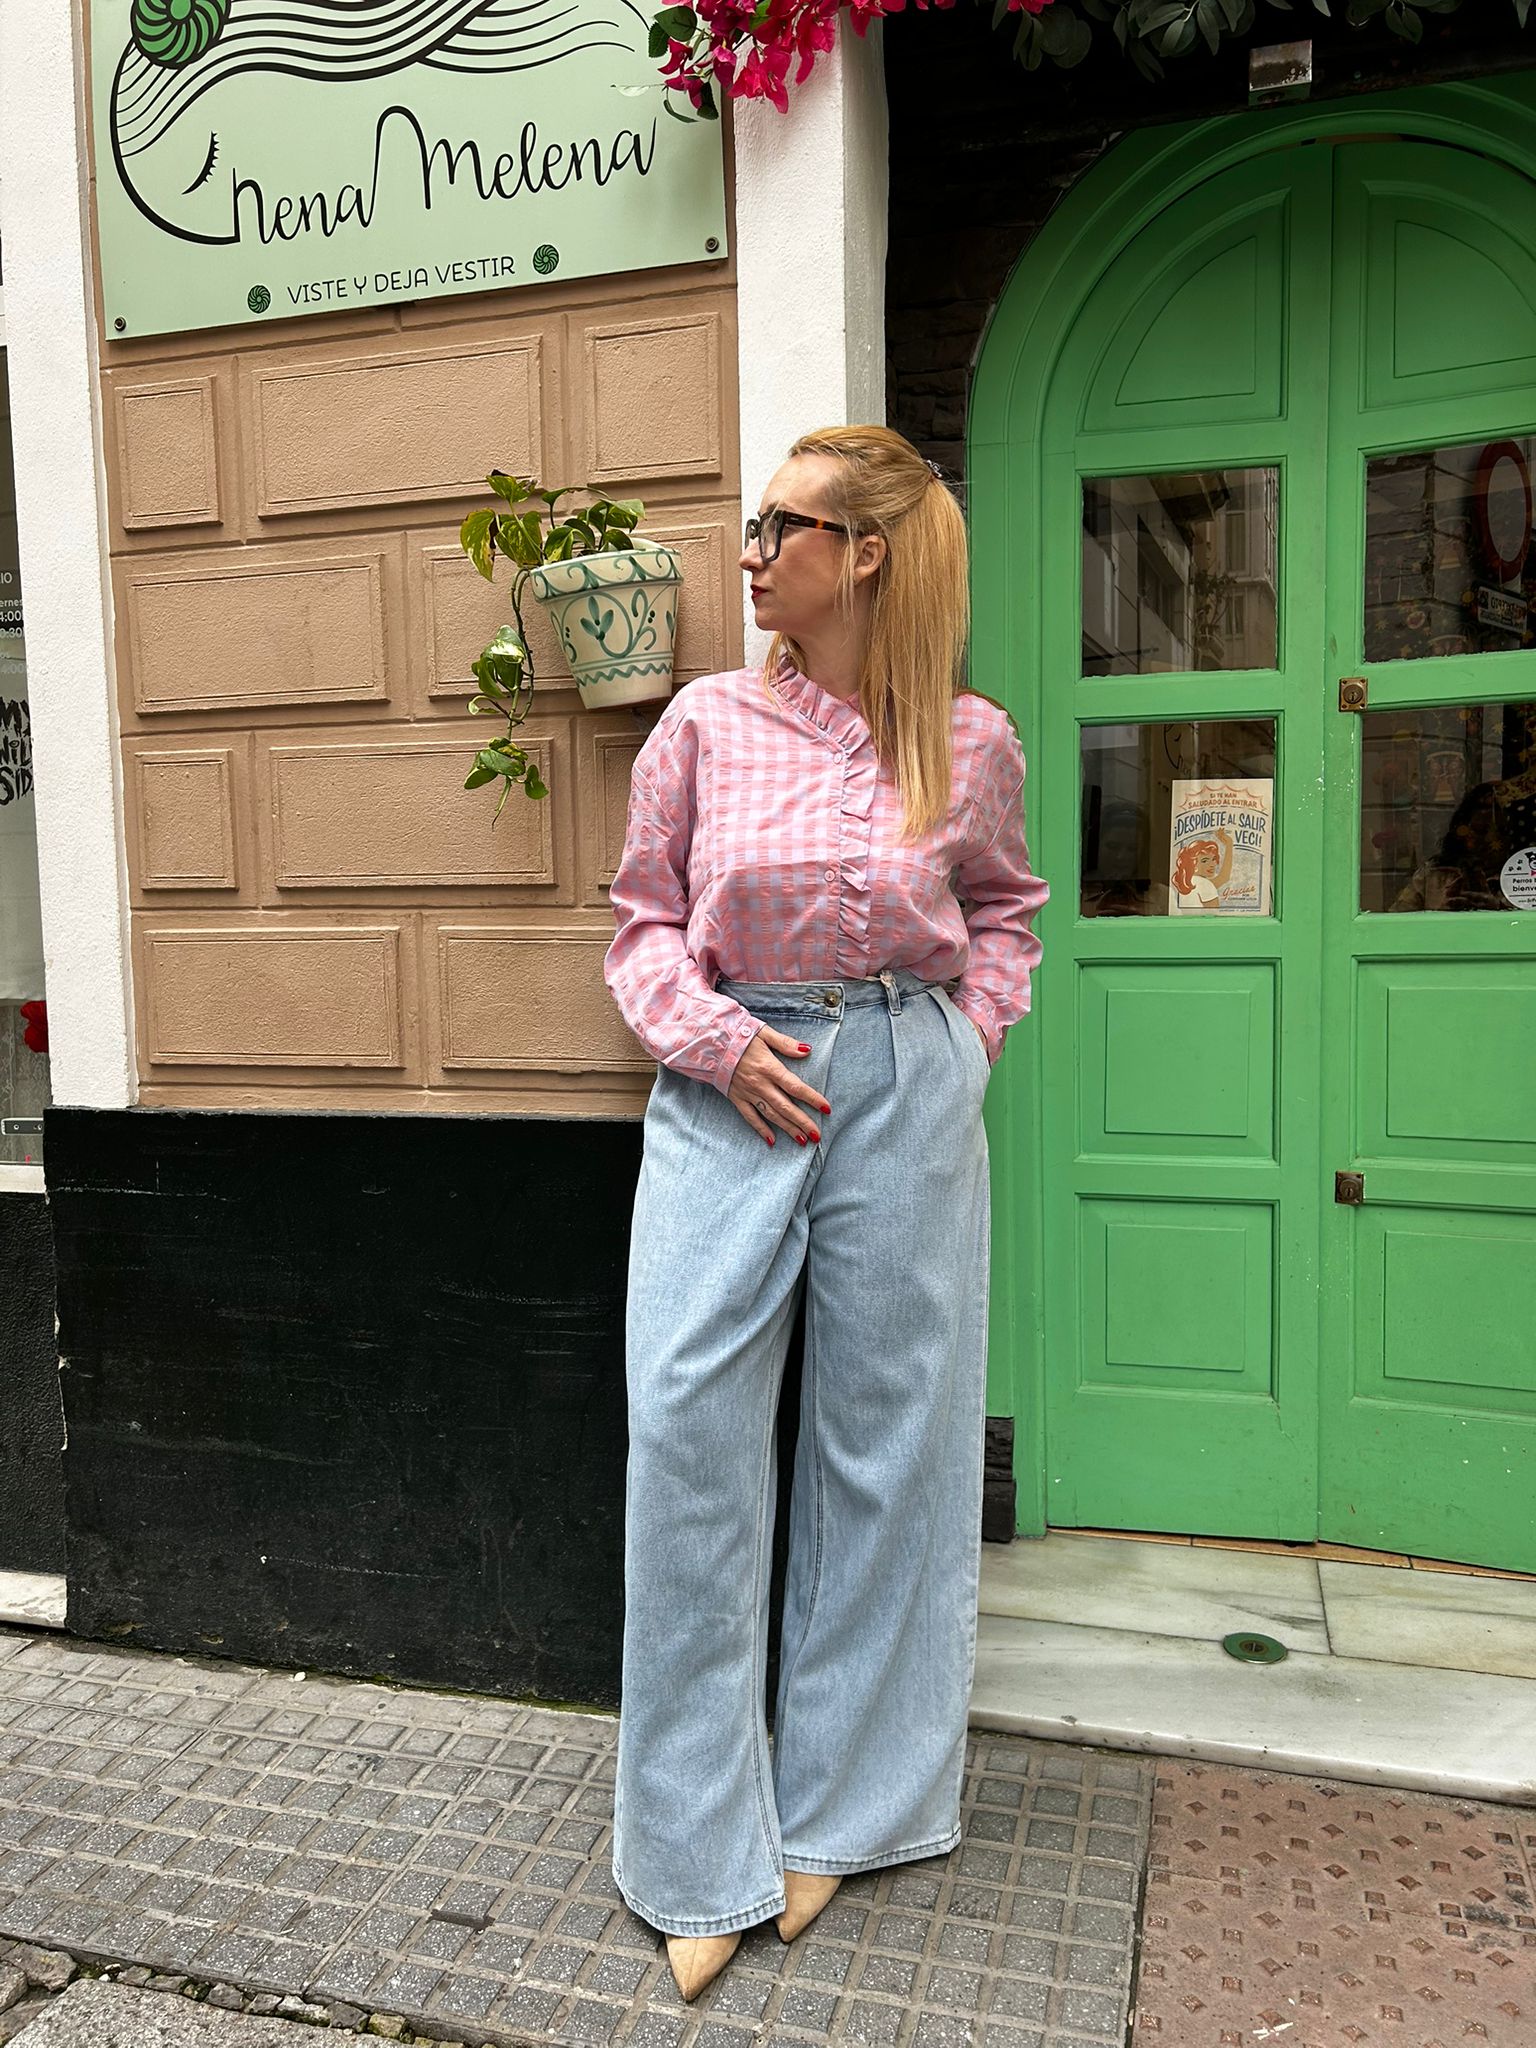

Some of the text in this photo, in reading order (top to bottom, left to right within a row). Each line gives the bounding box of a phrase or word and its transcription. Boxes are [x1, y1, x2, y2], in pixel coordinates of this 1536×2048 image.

[233, 105, 657, 244] nena Melena
[287, 255, 516, 304] VISTE Y DEJA VESTIR
[0, 765, 34, 807] SID
[1188, 800, 1221, 809] SALUDADO
[1232, 800, 1258, 808] ENTRAR
[1174, 810, 1266, 841] ¡DESPÍDETE AL SALIR
[1234, 829, 1262, 847] VECI!
